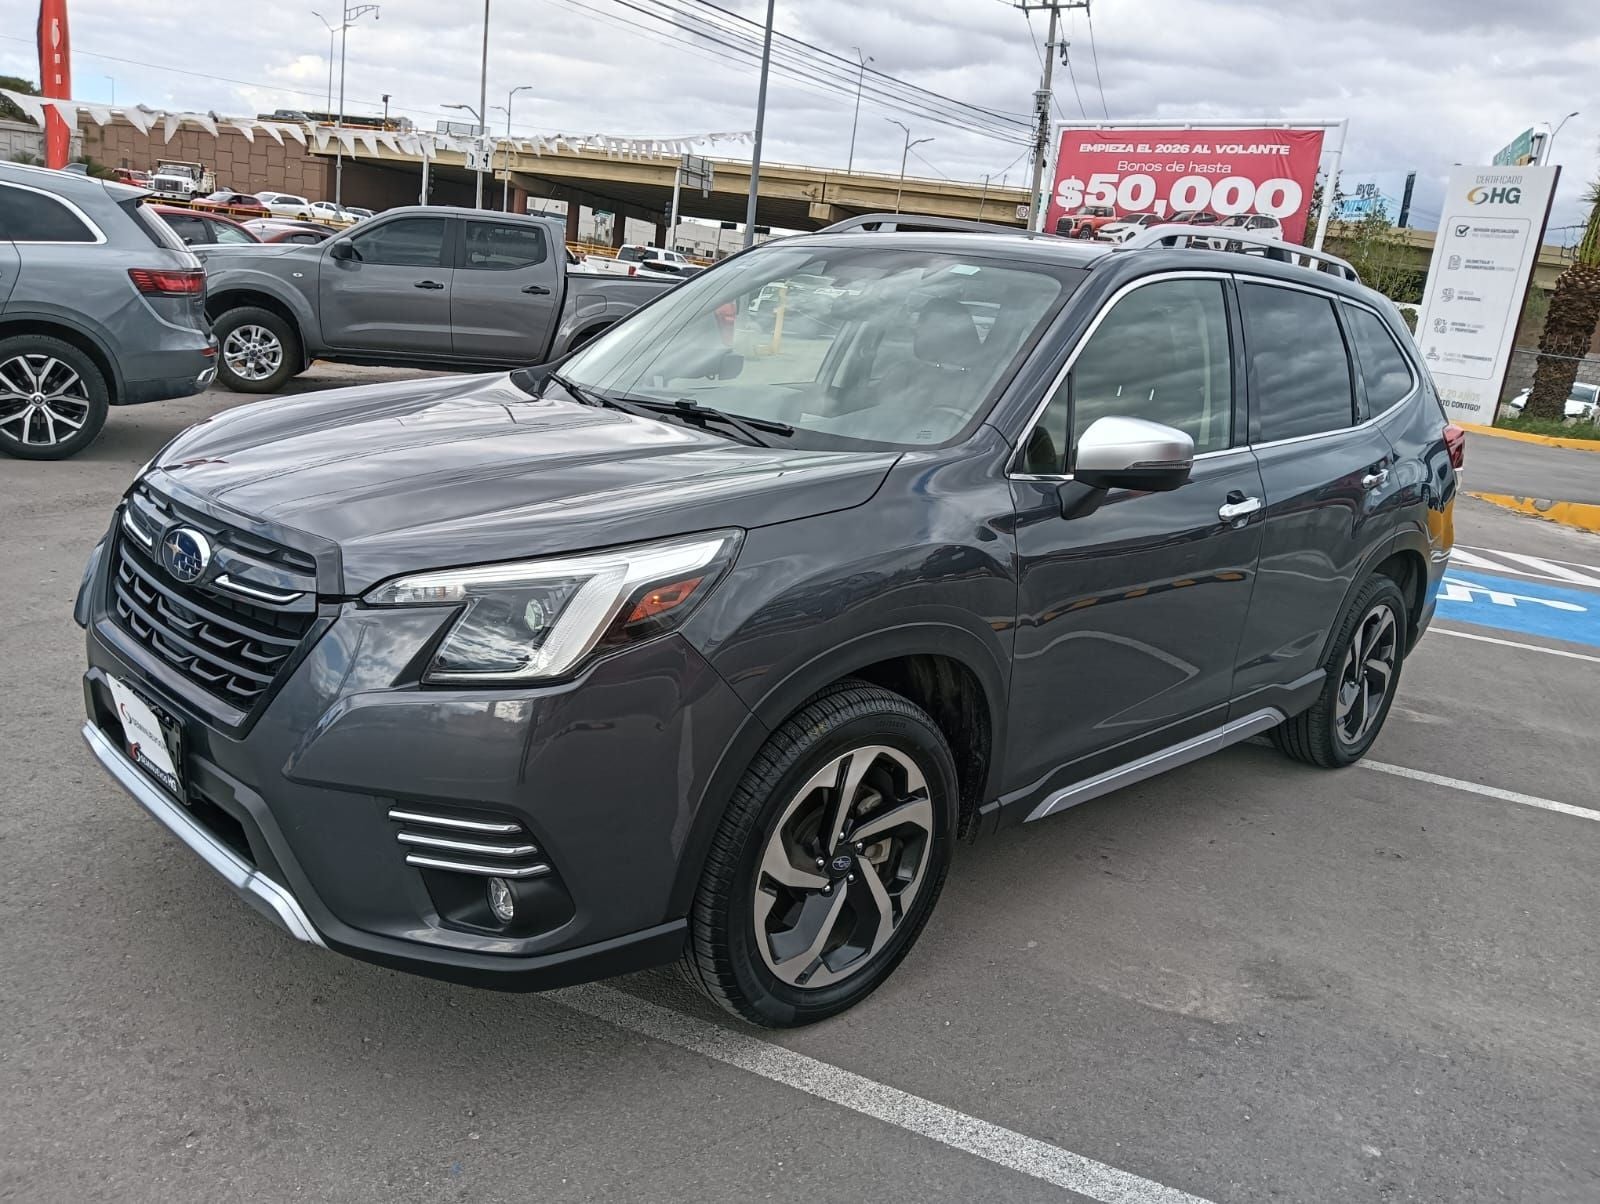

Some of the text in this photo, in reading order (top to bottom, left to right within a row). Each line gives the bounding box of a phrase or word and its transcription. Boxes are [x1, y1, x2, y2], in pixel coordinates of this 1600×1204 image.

[1079, 143, 1291, 155] EMPIEZA EL 2026 AL VOLANTE
[1117, 160, 1232, 174] Bonos de hasta
[1475, 175, 1523, 185] CERTIFICADO
[1056, 174, 1303, 219] $50,000
[1490, 187, 1522, 204] HG
